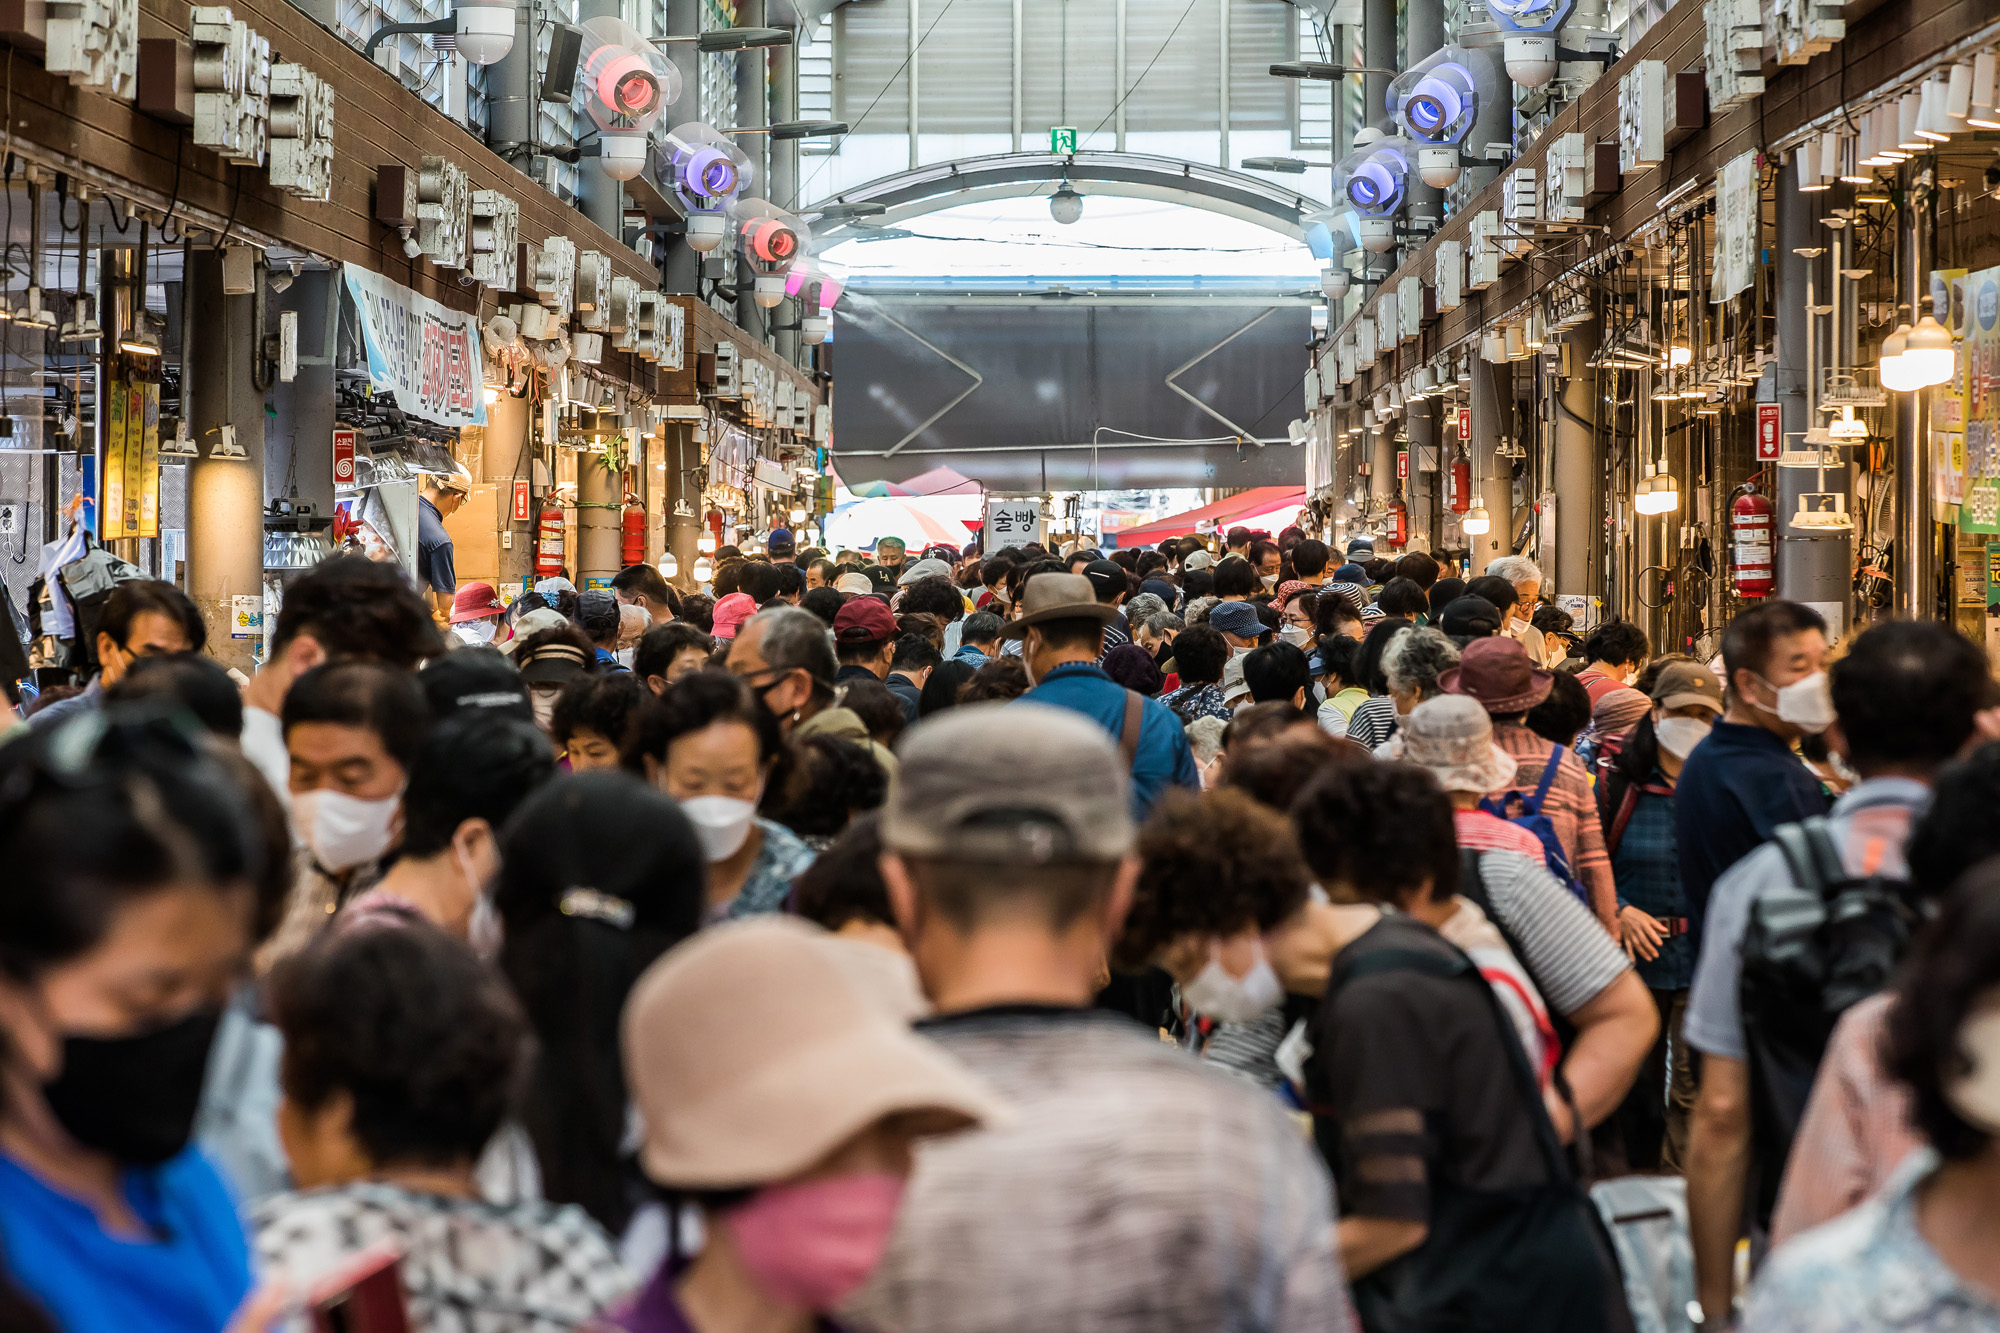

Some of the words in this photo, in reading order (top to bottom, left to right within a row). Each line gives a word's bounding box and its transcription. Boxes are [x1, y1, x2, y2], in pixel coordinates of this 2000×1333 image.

[336, 437, 353, 447] 소화전
[993, 508, 1037, 532] 술빵
[879, 570, 890, 582] LA
[1575, 597, 1590, 607] Strog
